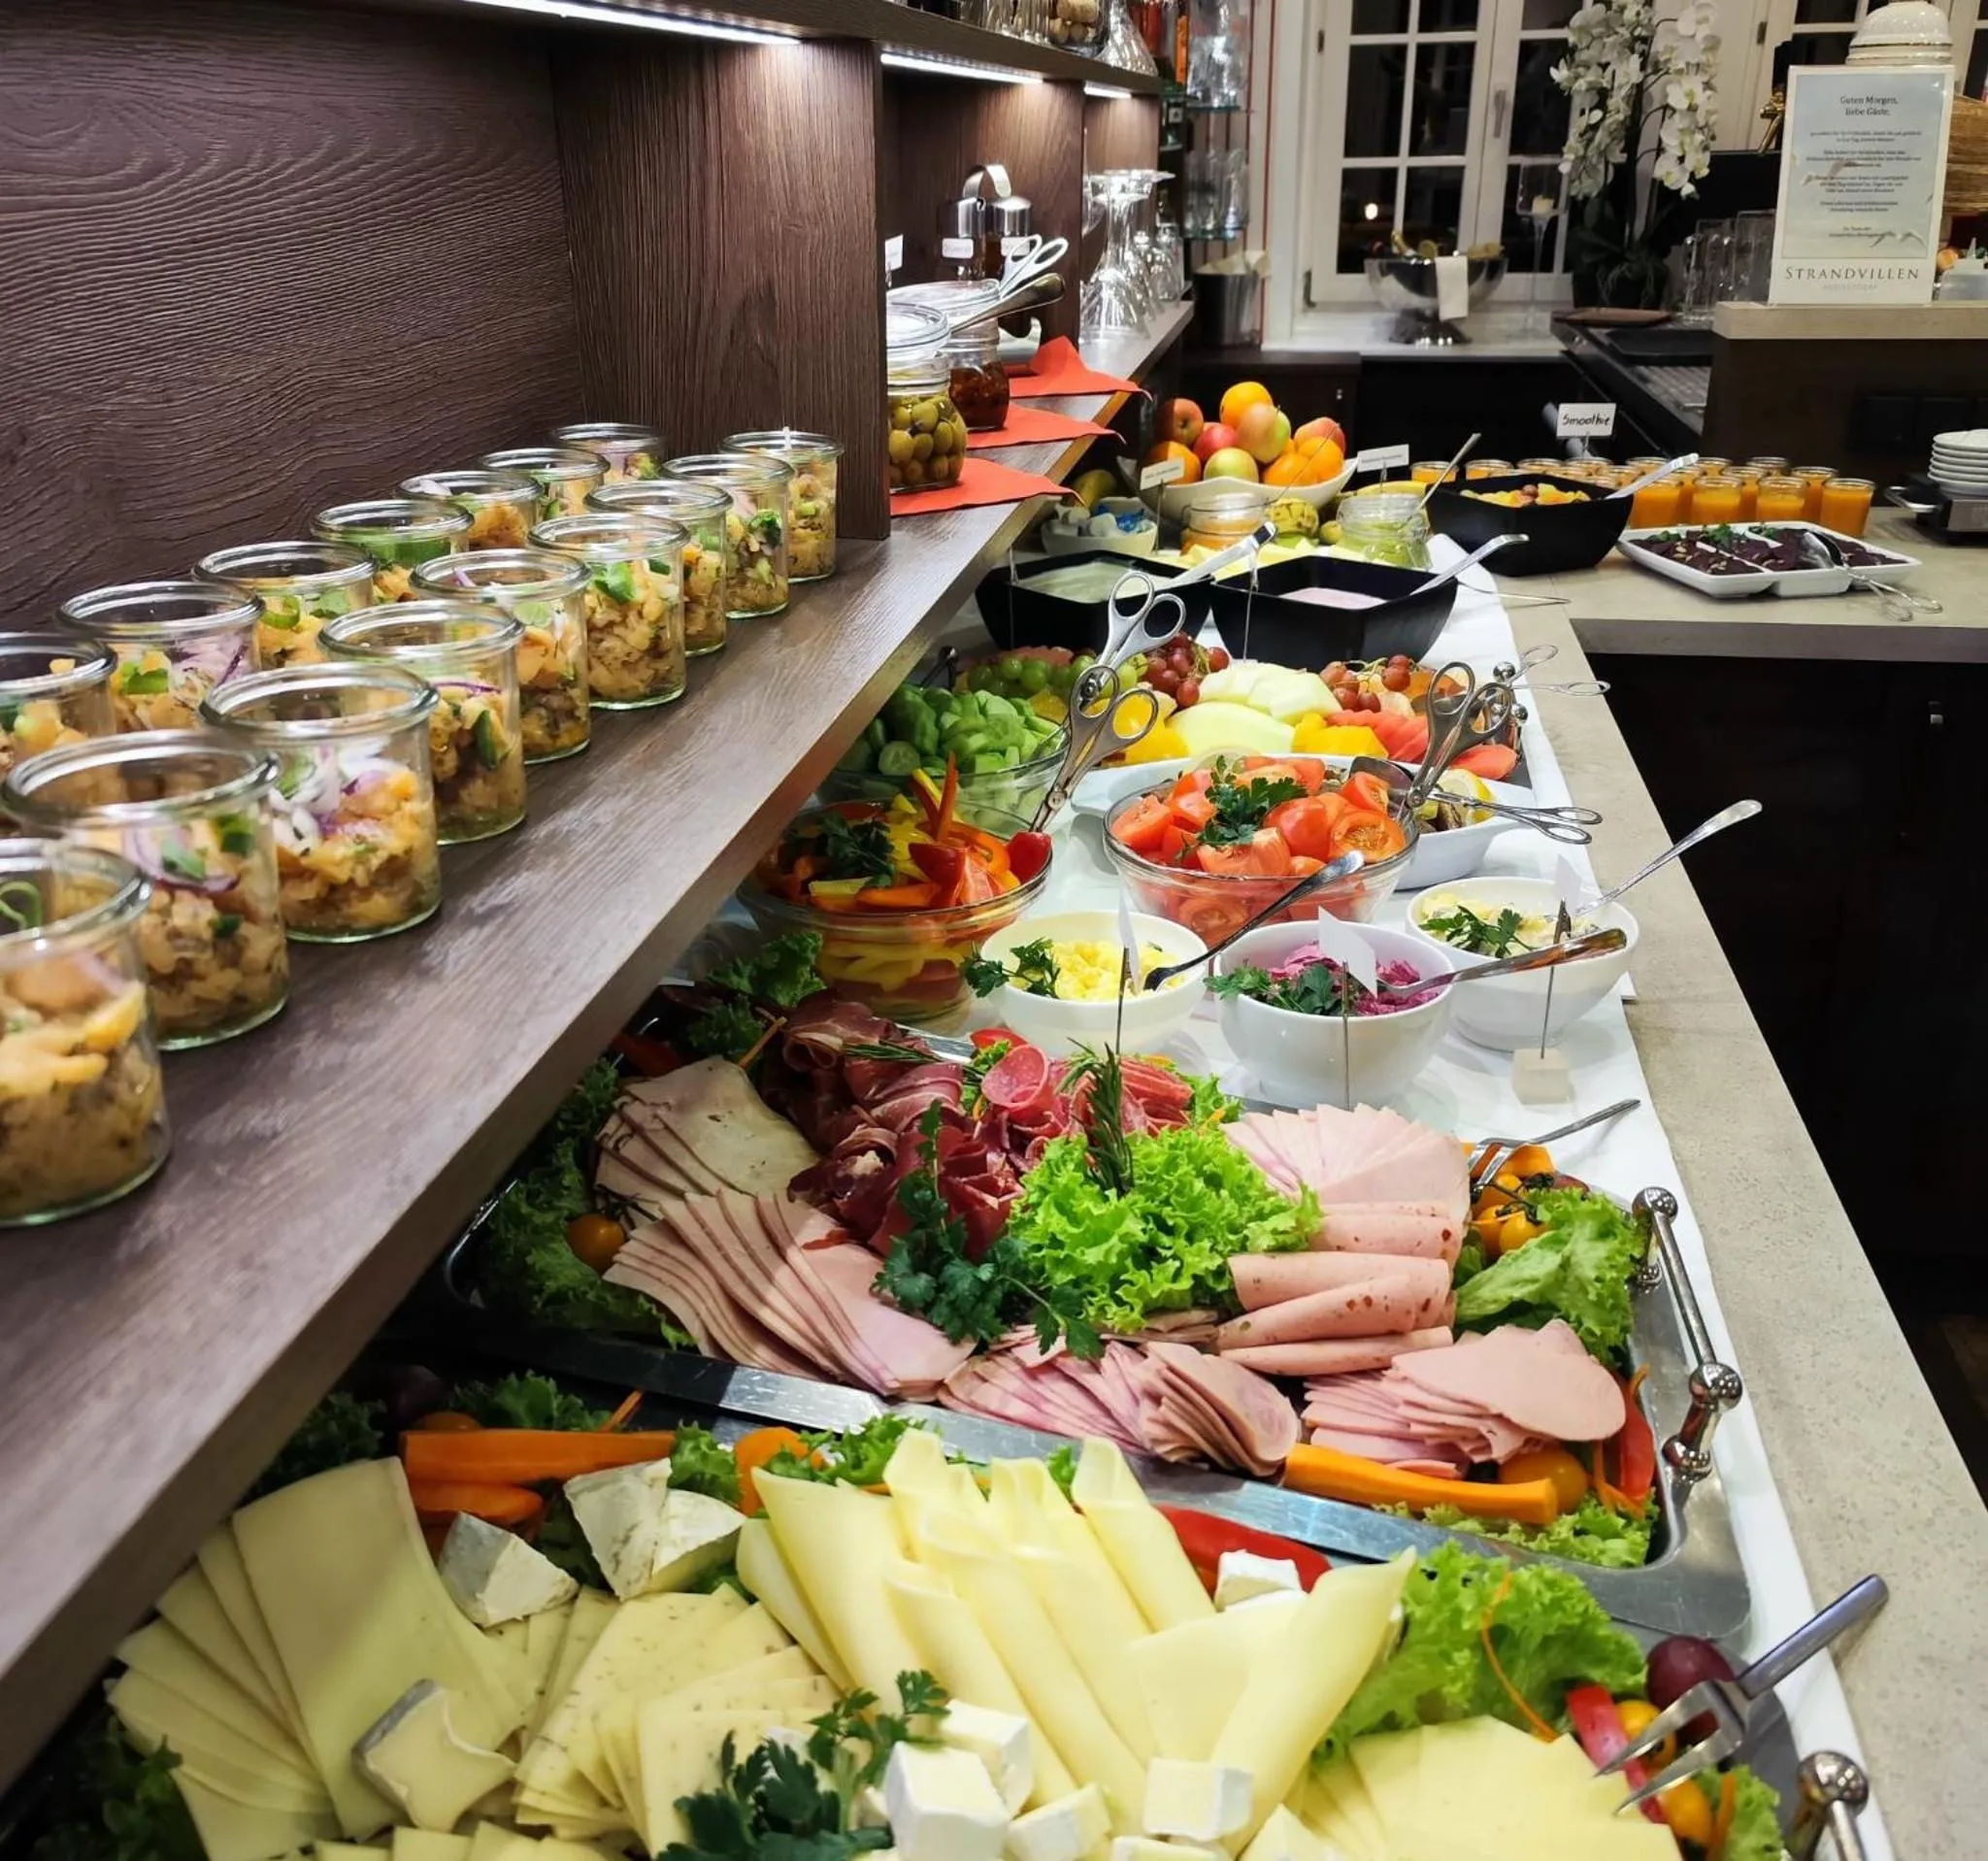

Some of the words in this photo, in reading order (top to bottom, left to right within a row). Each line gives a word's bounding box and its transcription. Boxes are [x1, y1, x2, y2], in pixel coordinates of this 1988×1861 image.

[1839, 95, 1864, 105] Guten
[1785, 265, 1919, 281] STRANDVILLEN
[1562, 414, 1610, 426] Smoothie
